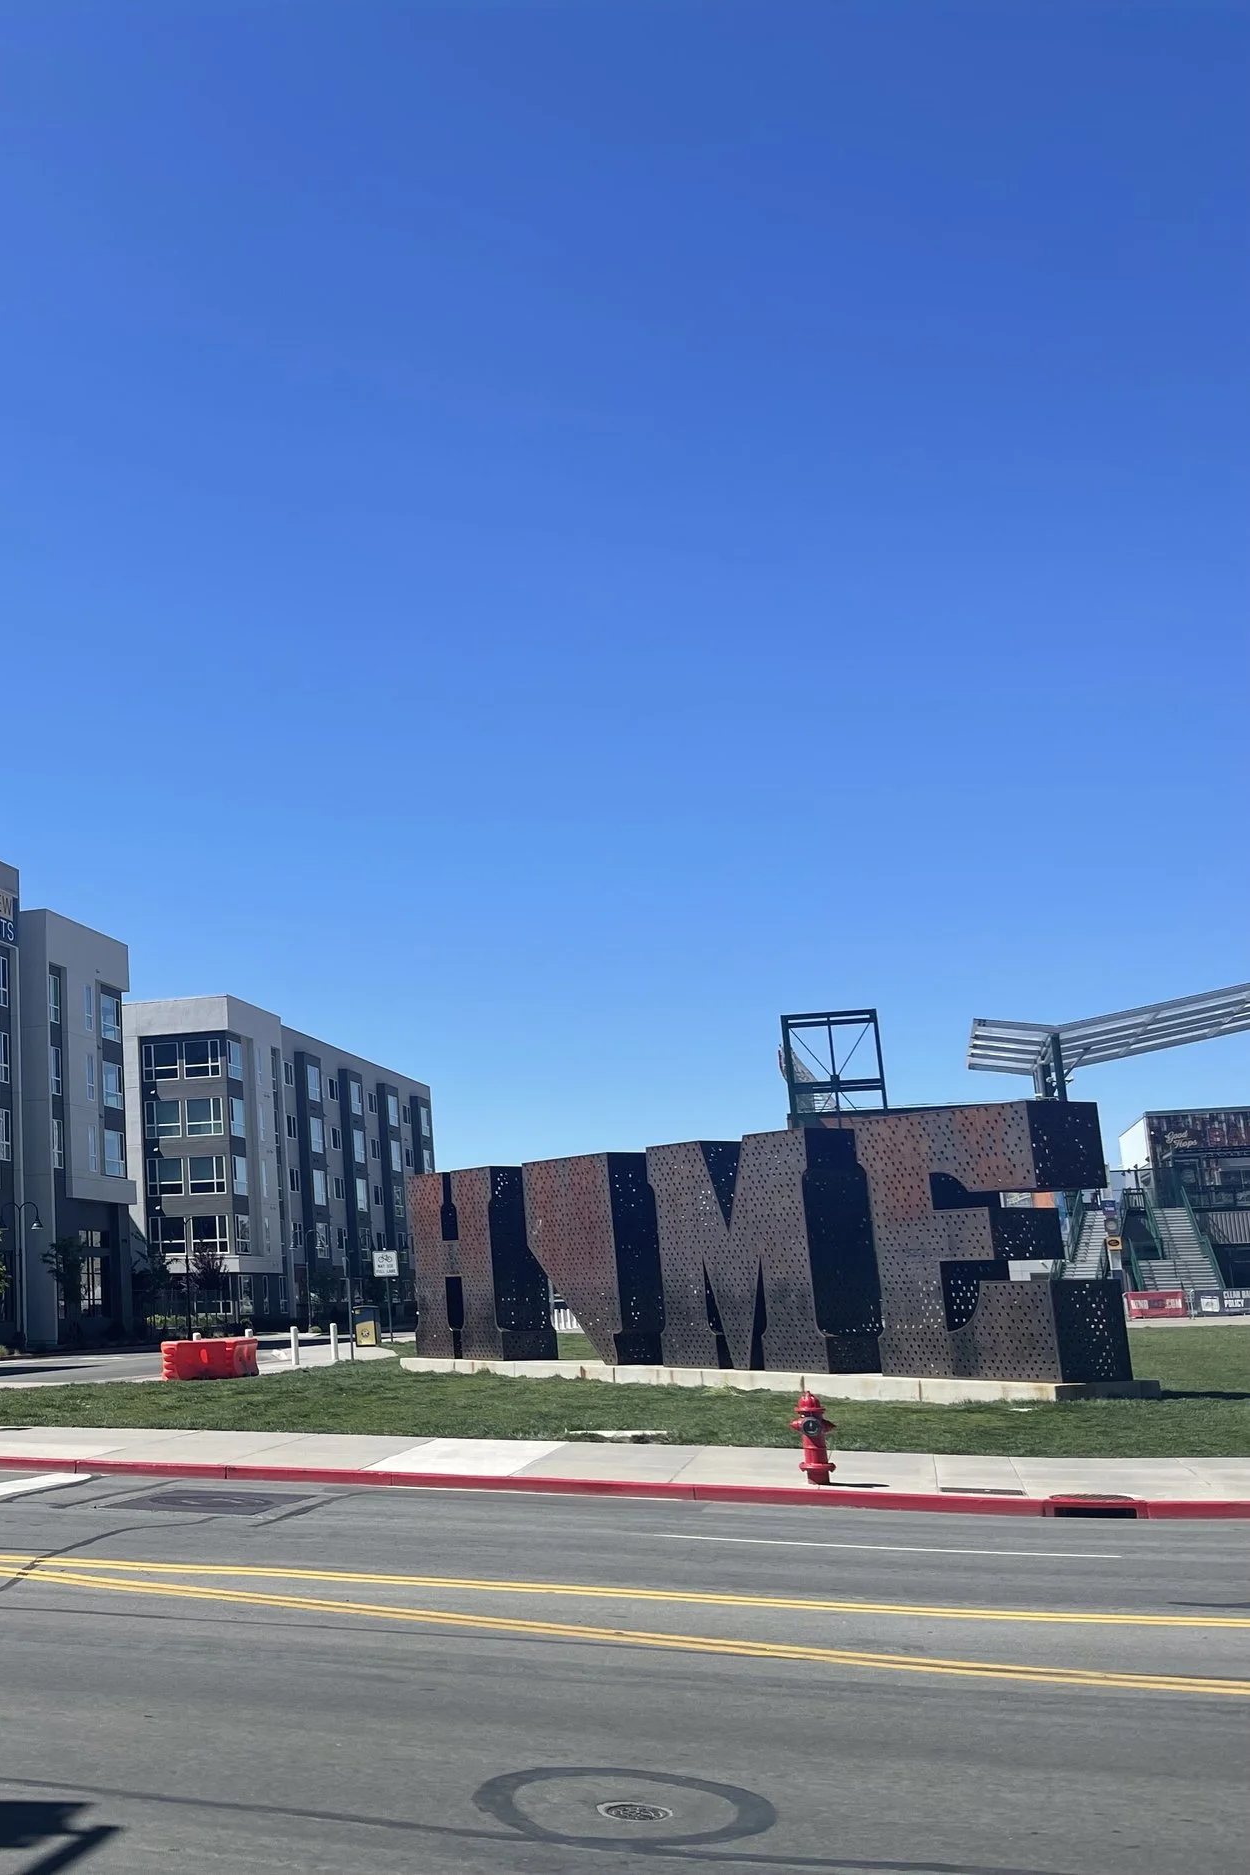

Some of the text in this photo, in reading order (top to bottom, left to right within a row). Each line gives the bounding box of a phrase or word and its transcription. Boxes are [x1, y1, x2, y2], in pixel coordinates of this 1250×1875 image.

[1164, 1130, 1188, 1144] Good
[1173, 1139, 1198, 1149] Hops
[1224, 1299, 1244, 1308] POLICY
